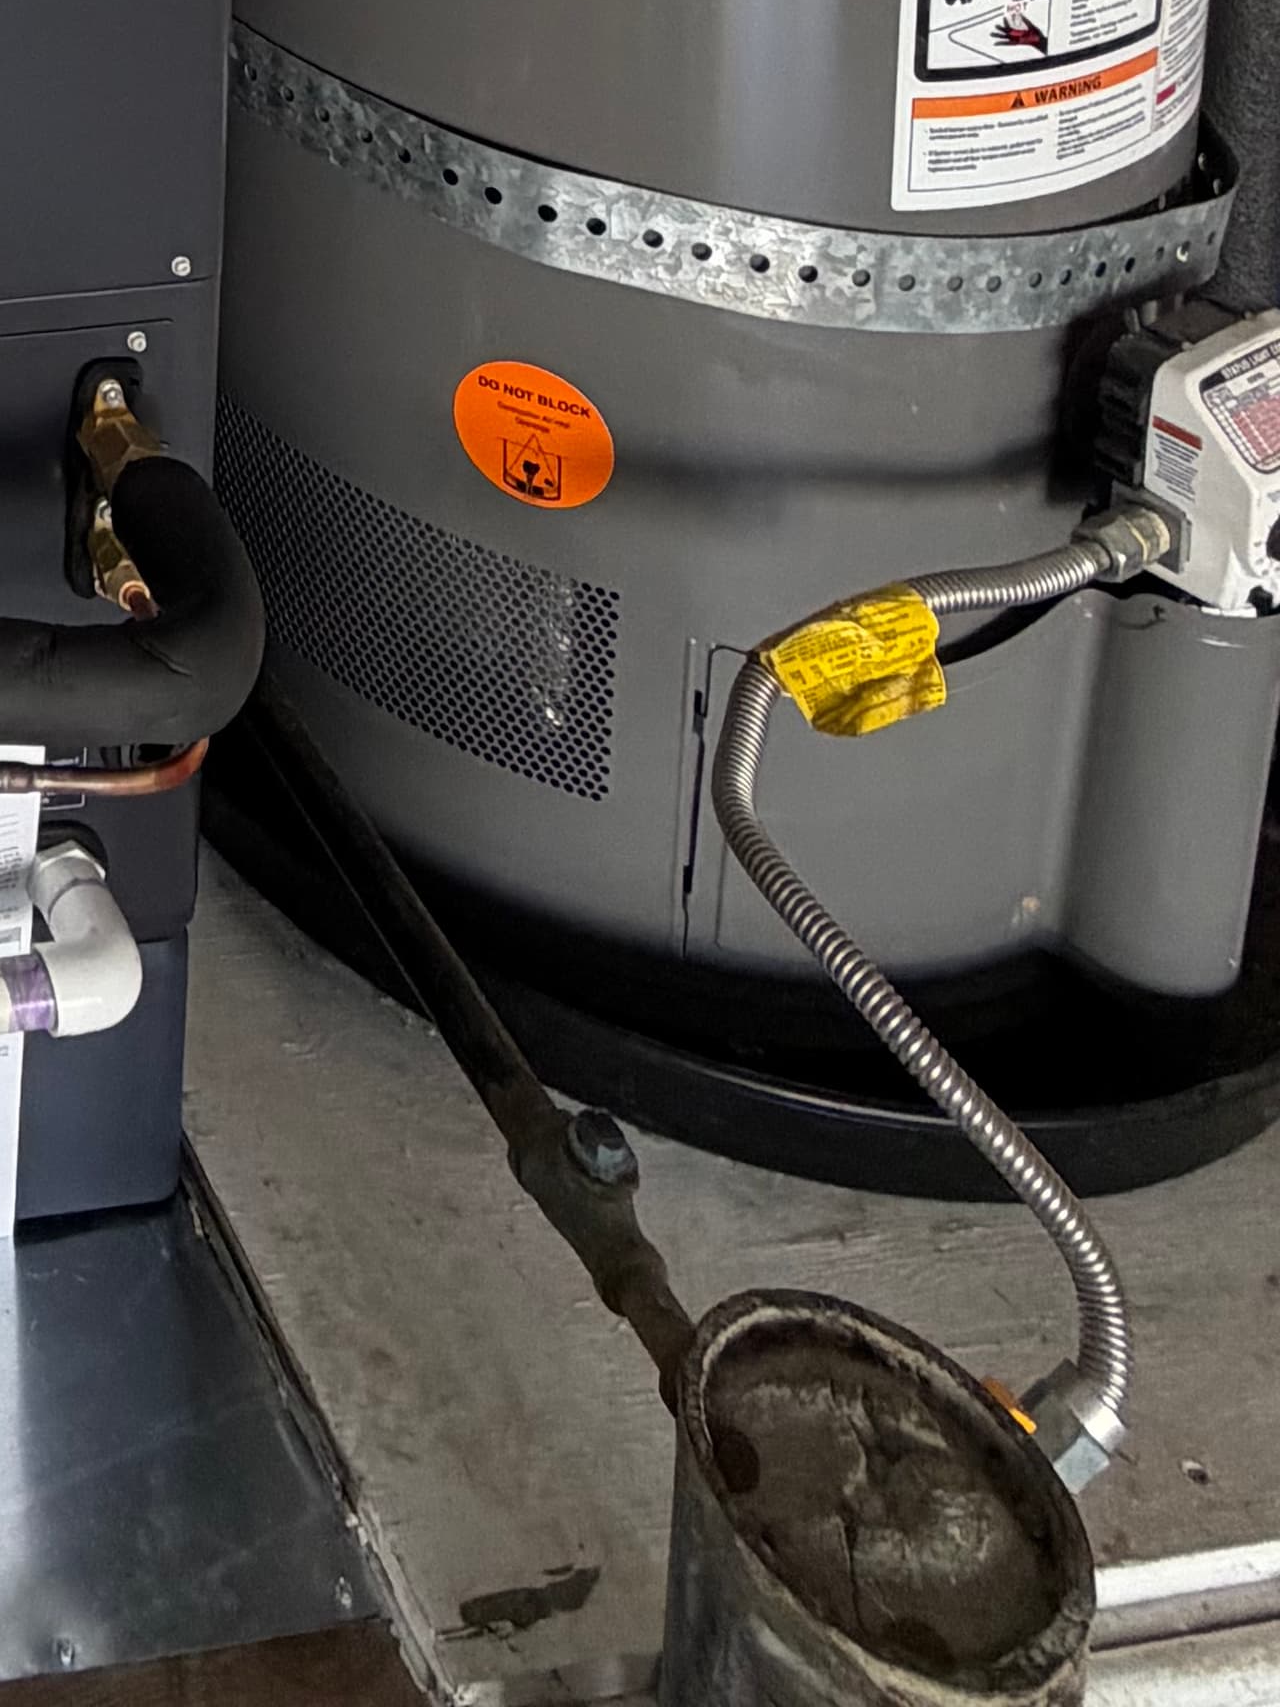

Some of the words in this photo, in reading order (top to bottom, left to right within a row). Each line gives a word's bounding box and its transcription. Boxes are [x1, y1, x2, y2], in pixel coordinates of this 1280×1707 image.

[1006, 2, 1028, 14] HOT
[1033, 76, 1103, 106] WARNING
[478, 375, 500, 391] DO
[503, 383, 535, 402] NOT
[537, 394, 591, 419] BLOCK
